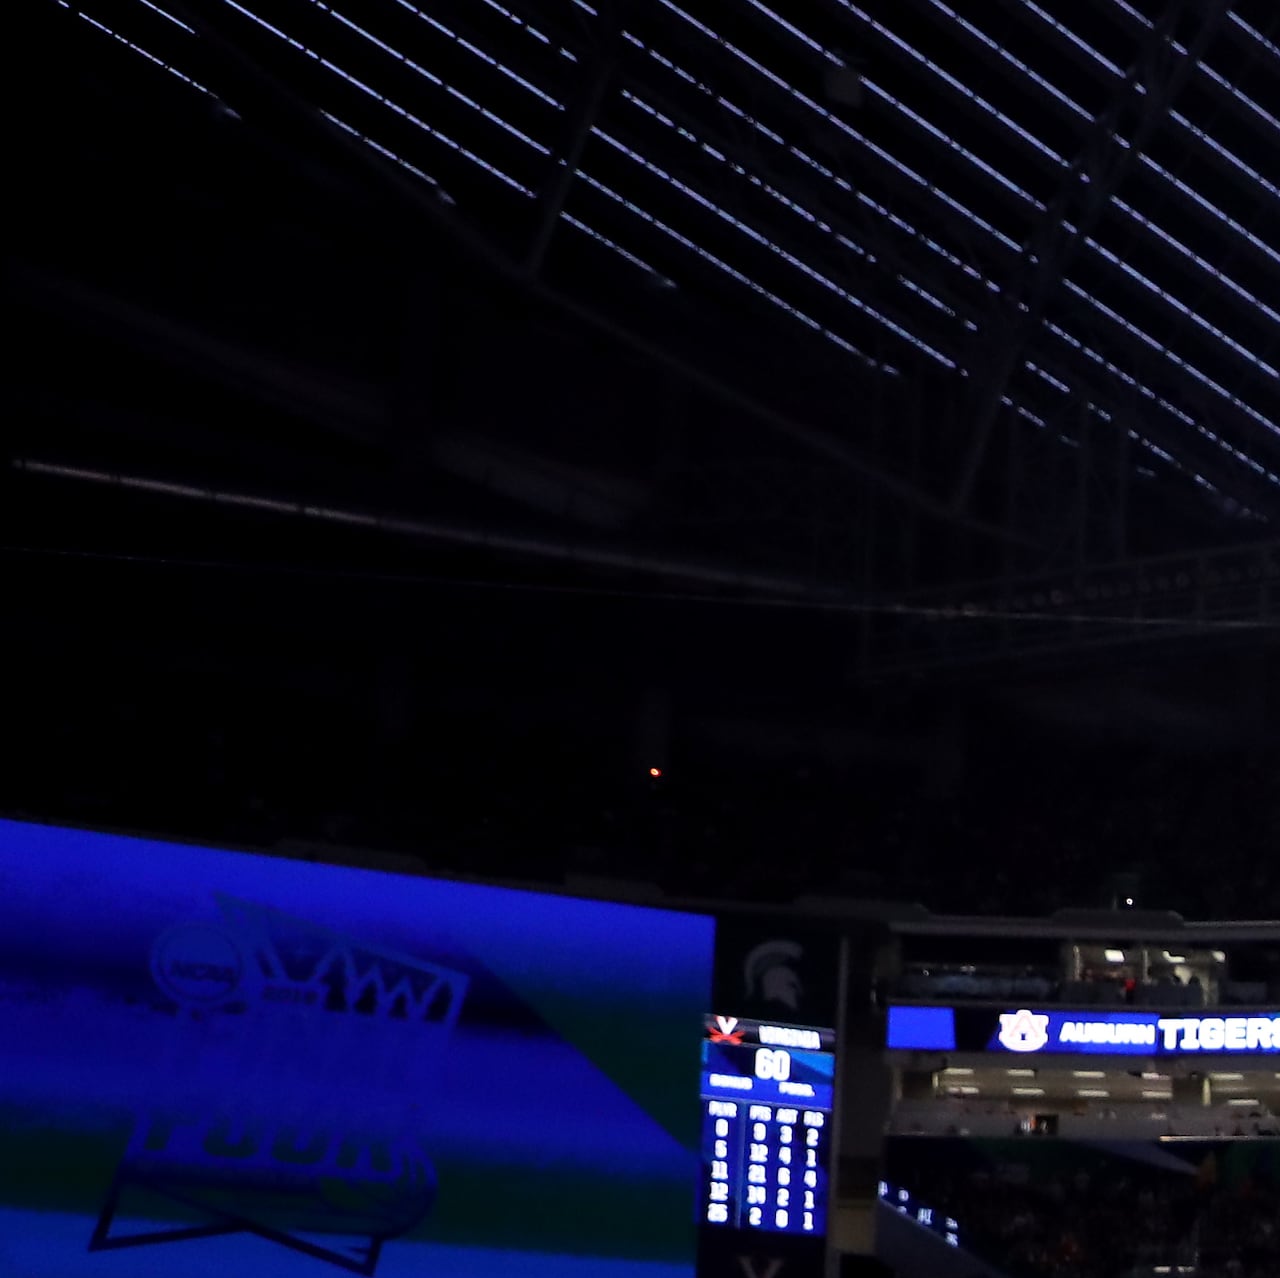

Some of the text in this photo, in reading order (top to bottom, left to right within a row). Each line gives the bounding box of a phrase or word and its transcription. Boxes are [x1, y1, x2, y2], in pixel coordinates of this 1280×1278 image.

[1059, 1022, 1155, 1044] AUBURN
[755, 1048, 790, 1081] 60
[807, 1128, 818, 1146] 2
[807, 1149, 816, 1167] 1
[712, 1161, 728, 1179] 11
[710, 1182, 728, 1201] 12
[777, 1188, 789, 1207] 2
[804, 1191, 814, 1209] 1
[750, 1207, 761, 1225] 2
[803, 1212, 813, 1230] 1
